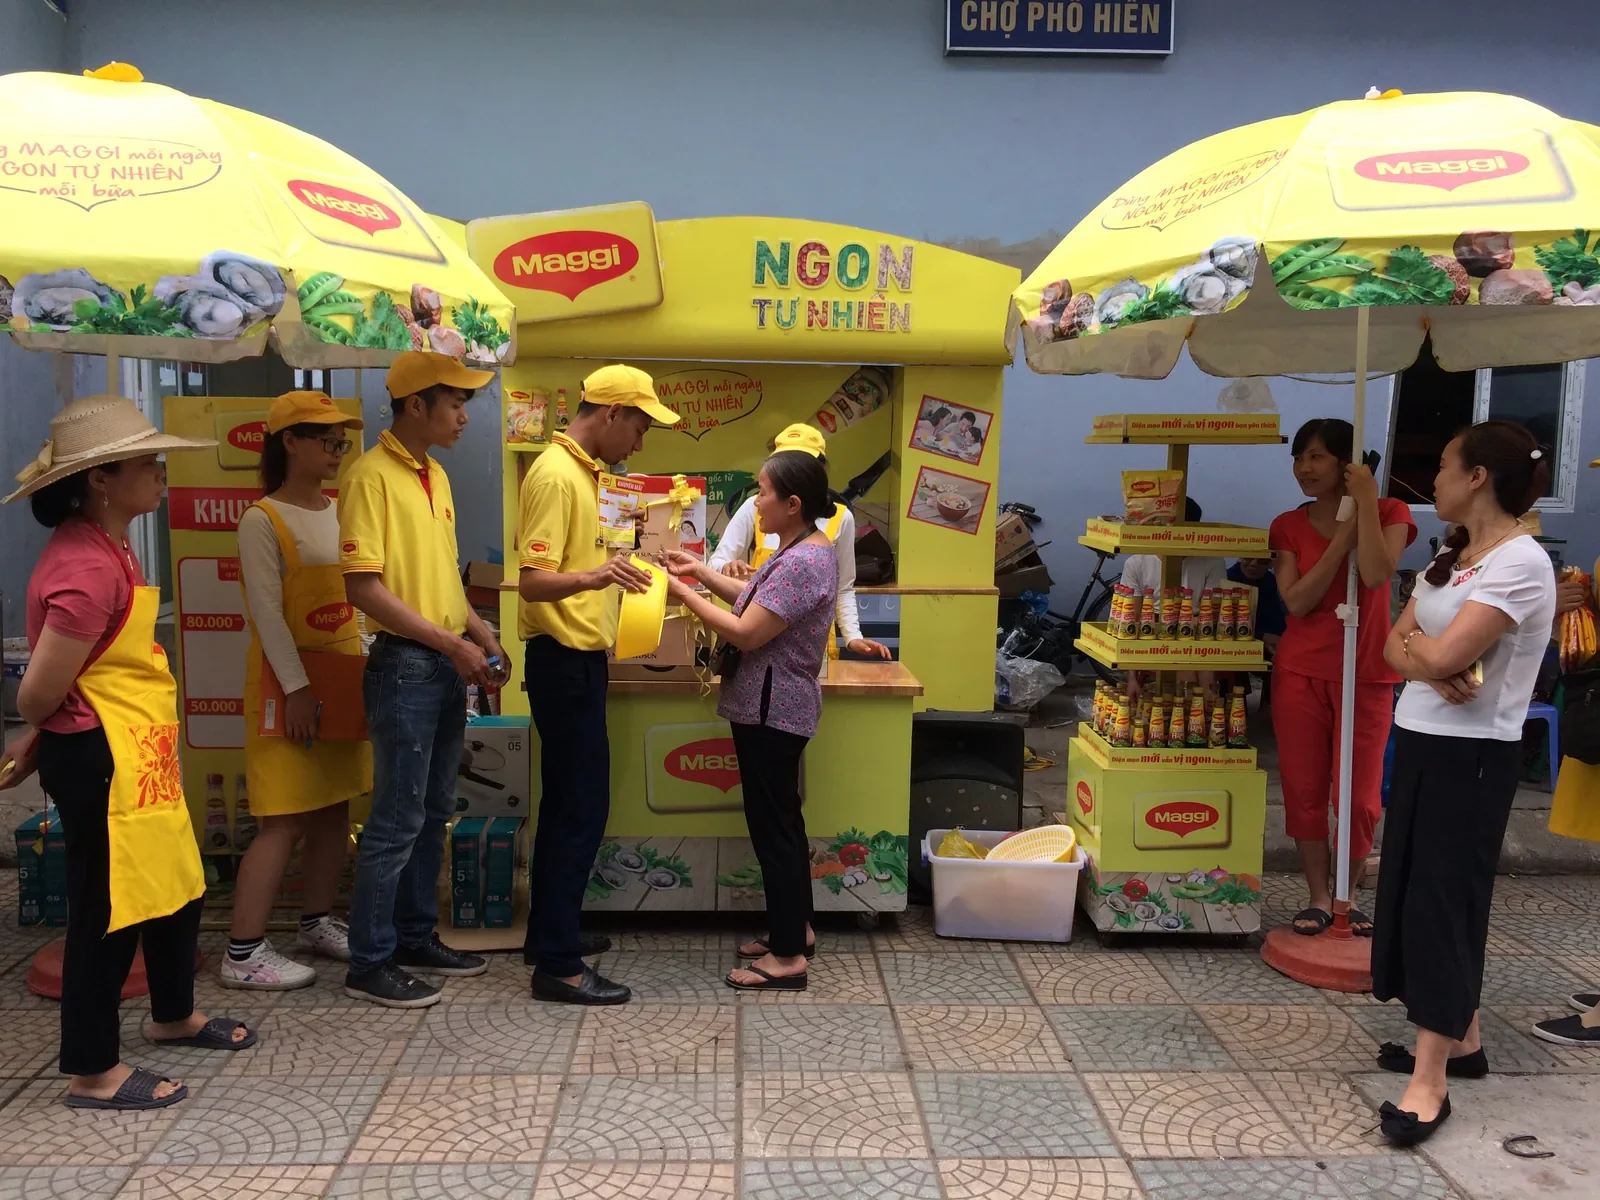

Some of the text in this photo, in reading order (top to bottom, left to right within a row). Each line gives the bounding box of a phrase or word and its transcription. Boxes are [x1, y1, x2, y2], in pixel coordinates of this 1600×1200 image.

[19, 142, 120, 160] MAGGI
[129, 149, 163, 160] mỗi
[169, 148, 222, 164] ngày
[0, 161, 57, 178] GON
[111, 163, 183, 181] NHIÊN
[1375, 155, 1509, 175] Maggi
[39, 182, 136, 198] mỗi bữa
[1155, 172, 1220, 199] MAGGI
[300, 187, 390, 221] Maggi
[1122, 199, 1170, 222] NGON
[1197, 172, 1252, 200] NHIÊN
[512, 244, 621, 277] Maggi
[752, 237, 914, 292] NGON
[752, 292, 912, 335] TỰ NHIÊN
[658, 378, 763, 397] MAGGI mỗi ngày
[706, 395, 744, 412] NHIÊN
[673, 417, 720, 431] mỗi bữa
[1161, 418, 1181, 428] mới
[1196, 418, 1206, 430] vị
[1207, 421, 1234, 430] ngon
[1151, 530, 1171, 541] mới
[1185, 532, 1195, 543] vị
[1197, 534, 1224, 545] ngon
[187, 616, 232, 628] 80.000
[1149, 645, 1169, 654] mới
[1183, 646, 1193, 656] vị
[1194, 648, 1220, 657] ngon
[191, 701, 236, 712] 50.000
[508, 741, 521, 751] 05
[680, 754, 739, 771] Mag
[1140, 753, 1160, 763] mới
[1174, 754, 1183, 765] vị
[1185, 756, 1211, 765] ngon
[1155, 811, 1209, 823] Maggi
[19, 868, 28, 878] 5
[456, 870, 465, 882] 5
